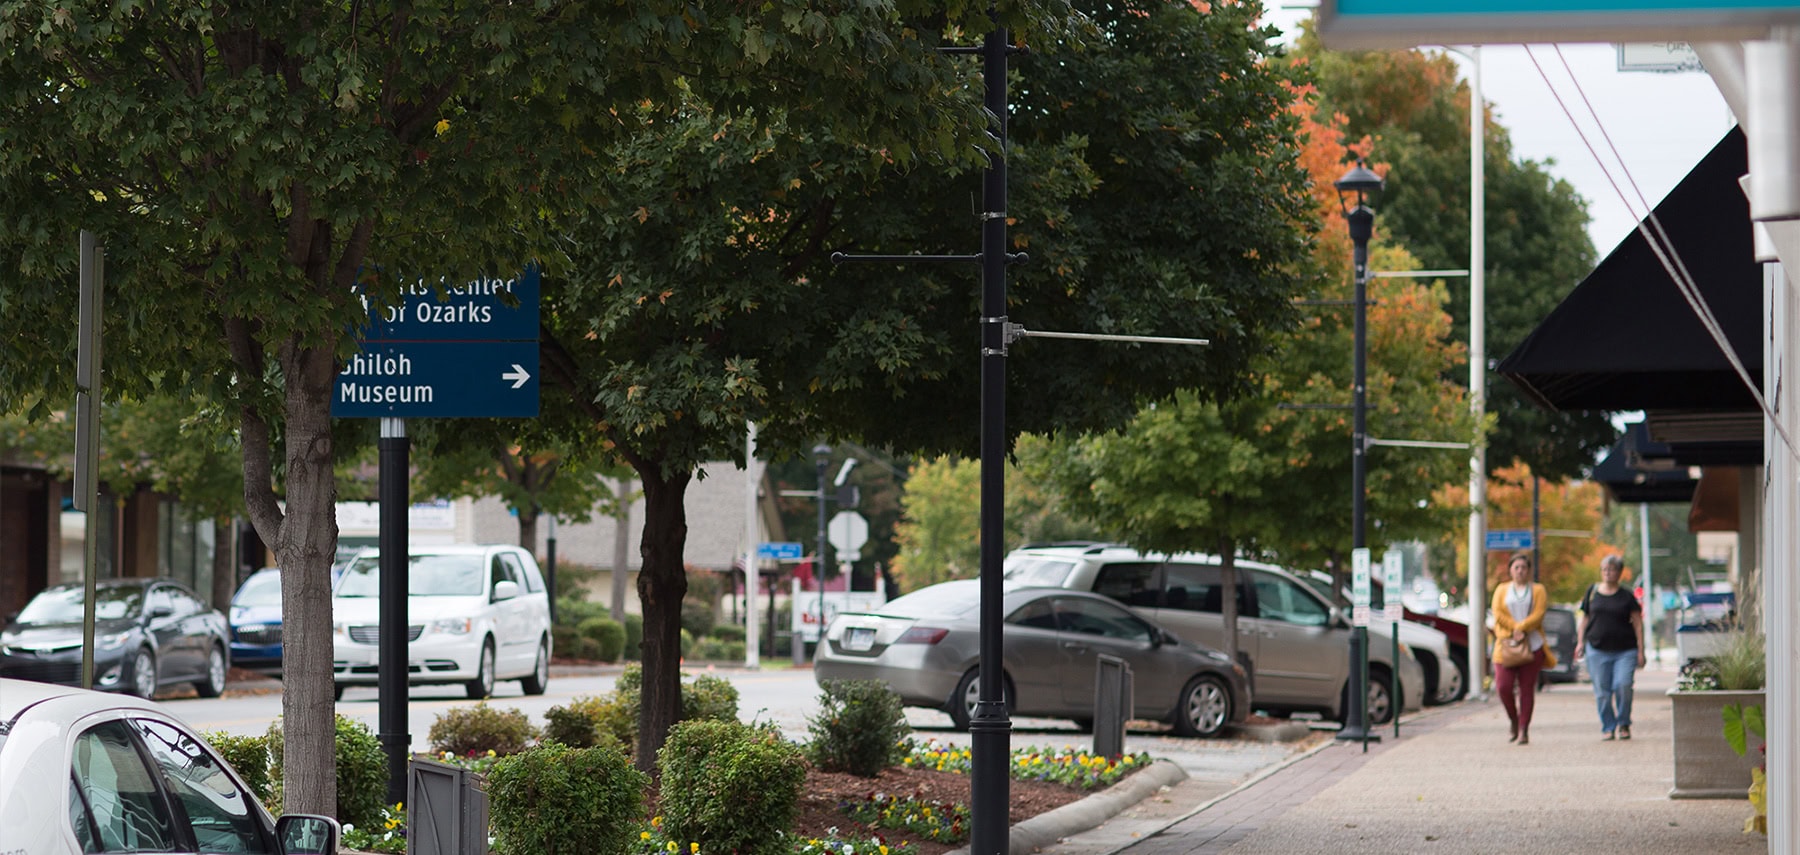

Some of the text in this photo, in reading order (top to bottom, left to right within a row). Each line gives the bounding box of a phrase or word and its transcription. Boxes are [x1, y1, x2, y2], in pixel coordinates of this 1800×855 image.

[439, 275, 515, 296] enter
[416, 301, 492, 323] Ozarks
[340, 382, 433, 403] Museum
